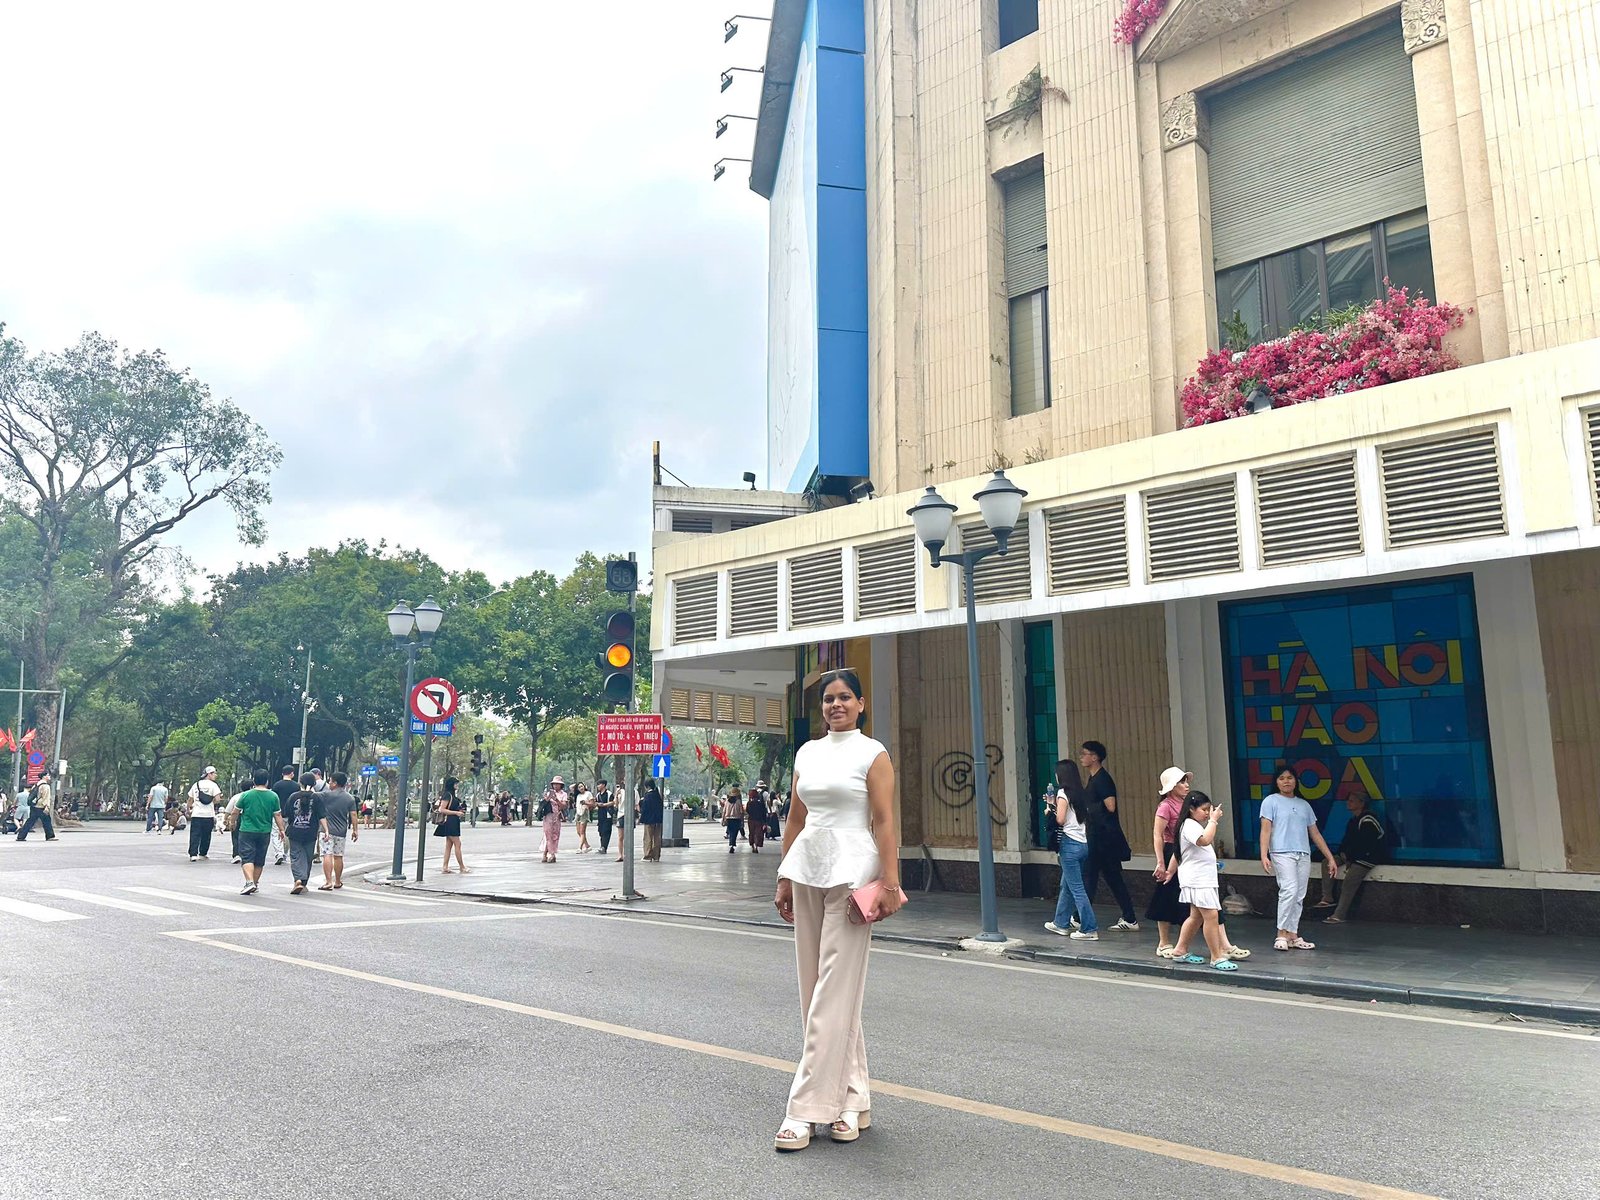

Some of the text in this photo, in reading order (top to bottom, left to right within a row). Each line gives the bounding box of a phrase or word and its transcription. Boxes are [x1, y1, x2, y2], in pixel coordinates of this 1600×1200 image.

[1353, 631, 1464, 698] NỘI
[607, 731, 616, 740] MÔ
[644, 731, 658, 741] TRIỆU
[643, 742, 658, 752] TRIỆU
[1248, 757, 1384, 800] HOA
